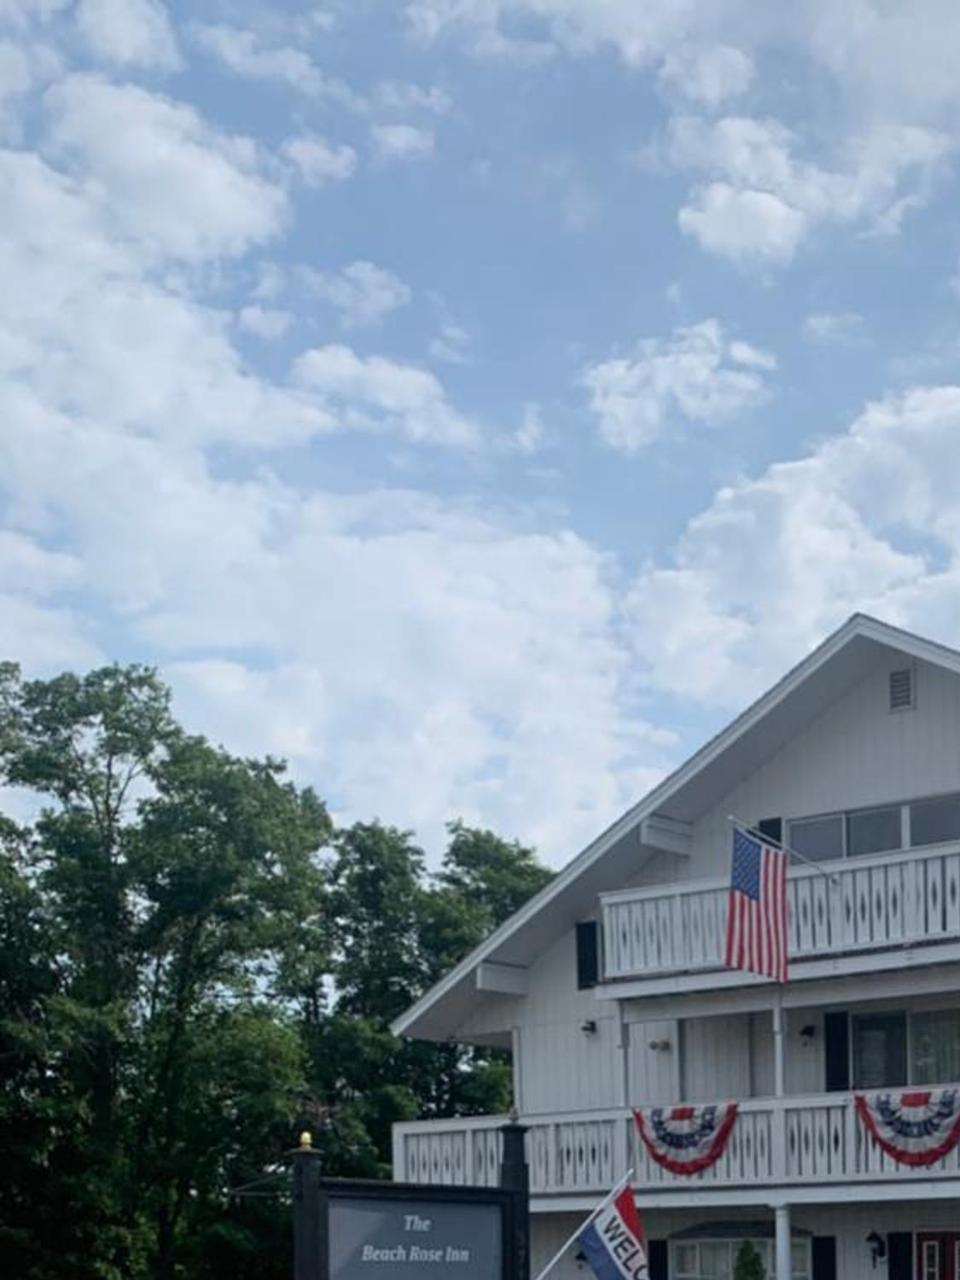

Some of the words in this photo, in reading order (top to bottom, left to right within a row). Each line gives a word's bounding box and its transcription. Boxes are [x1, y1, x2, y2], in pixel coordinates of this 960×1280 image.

[404, 1215, 431, 1231] The
[362, 1245, 407, 1262] Beach
[410, 1246, 443, 1262] Rose
[446, 1246, 469, 1262] Inn
